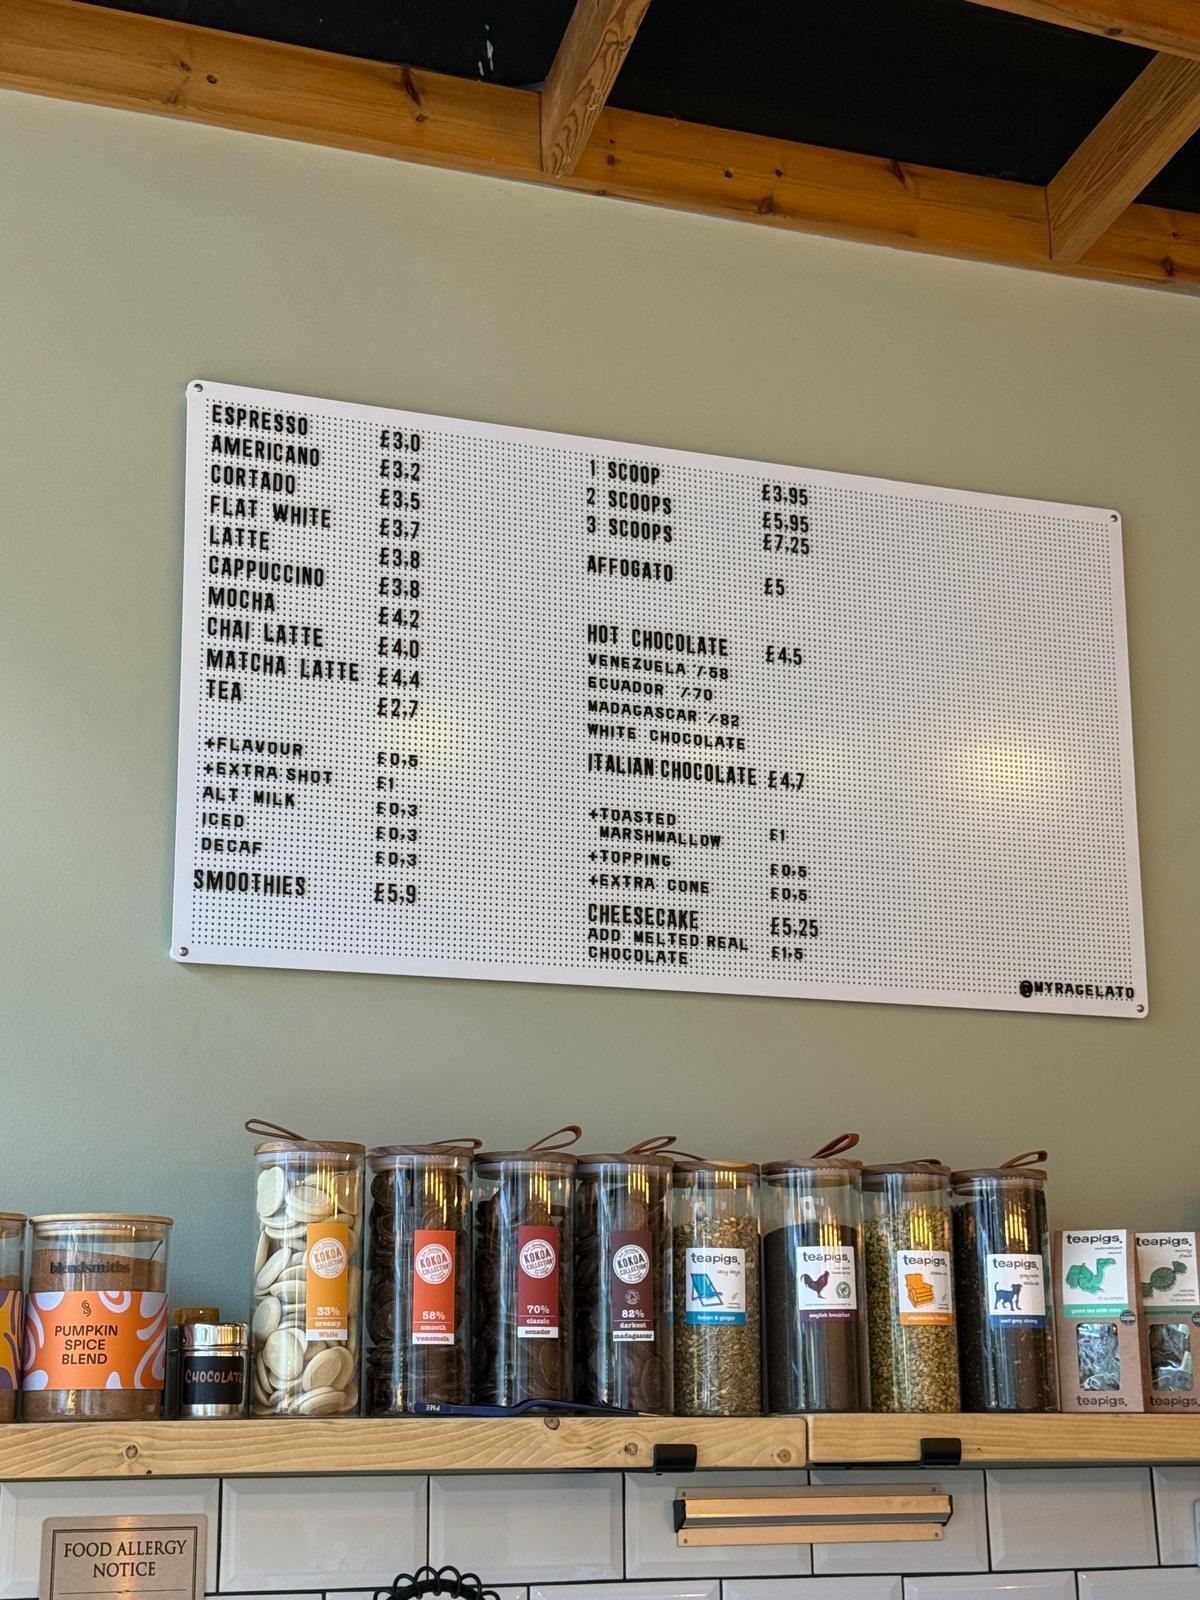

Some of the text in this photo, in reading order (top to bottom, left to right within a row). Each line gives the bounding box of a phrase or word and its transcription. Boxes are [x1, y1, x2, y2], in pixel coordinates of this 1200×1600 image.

[212, 404, 308, 435] ESPRESSO
[212, 434, 320, 466] AMERICANO
[211, 465, 295, 494] CORTADO
[590, 460, 660, 485] 1 SCOOP
[210, 495, 331, 528] FLAT WHITE
[587, 488, 671, 515] 2 SCOOPS
[209, 526, 269, 550] LATTE
[587, 516, 672, 542] 3 SCOOPS
[209, 556, 324, 587] CAPPUCCINO
[588, 555, 672, 582] AFFOGATO
[764, 578, 785, 596] £5
[208, 587, 274, 612] MOCHA
[208, 617, 323, 647] CHAI LATTE
[588, 624, 728, 656] HOT CHOCOLATE
[207, 649, 358, 681] MATCHA LATTE
[589, 654, 686, 676] VENEZUELA
[207, 679, 242, 700] TEA
[589, 677, 664, 696] ECUADOR
[588, 700, 697, 722] MADAGASCAR
[204, 737, 302, 756] +FLAVOUR
[588, 724, 746, 750] WHITE CHOCOLATE
[204, 762, 333, 784] +EXTRA SHOT
[588, 753, 757, 786] ITALIAN CHOCOLATE
[377, 777, 395, 792] £1
[203, 786, 295, 806] ALT MILK
[202, 813, 244, 827] ICED
[589, 808, 676, 825] +TOASTED
[201, 838, 262, 854] DECAF
[600, 826, 721, 848] MARSHMALLOW
[770, 829, 786, 843] £1
[589, 850, 671, 866] +TOPPING
[194, 870, 306, 896] SMOOTHIES
[589, 874, 709, 894] +EXTRA CONE
[588, 904, 699, 929] CHEESECAKE
[588, 928, 748, 950] ADD MELTED REAL
[589, 947, 688, 964] CHOCOLATE
[1020, 980, 1134, 998] @MYRAGELATO
[314, 1247, 342, 1263] KOKOA
[420, 1253, 447, 1269] KOKOA
[524, 1248, 551, 1264] KOKOA
[617, 1254, 644, 1269] KOKOA
[422, 1311, 446, 1320] 58%
[527, 1305, 550, 1314] 70%
[621, 1310, 644, 1318] 82%
[55, 1324, 118, 1336] PUMPKIN
[64, 1339, 105, 1350] SPICE
[62, 1353, 107, 1365] BLEND
[64, 1540, 187, 1557] FOOD ALLERGY
[93, 1562, 156, 1578] NOTICE
